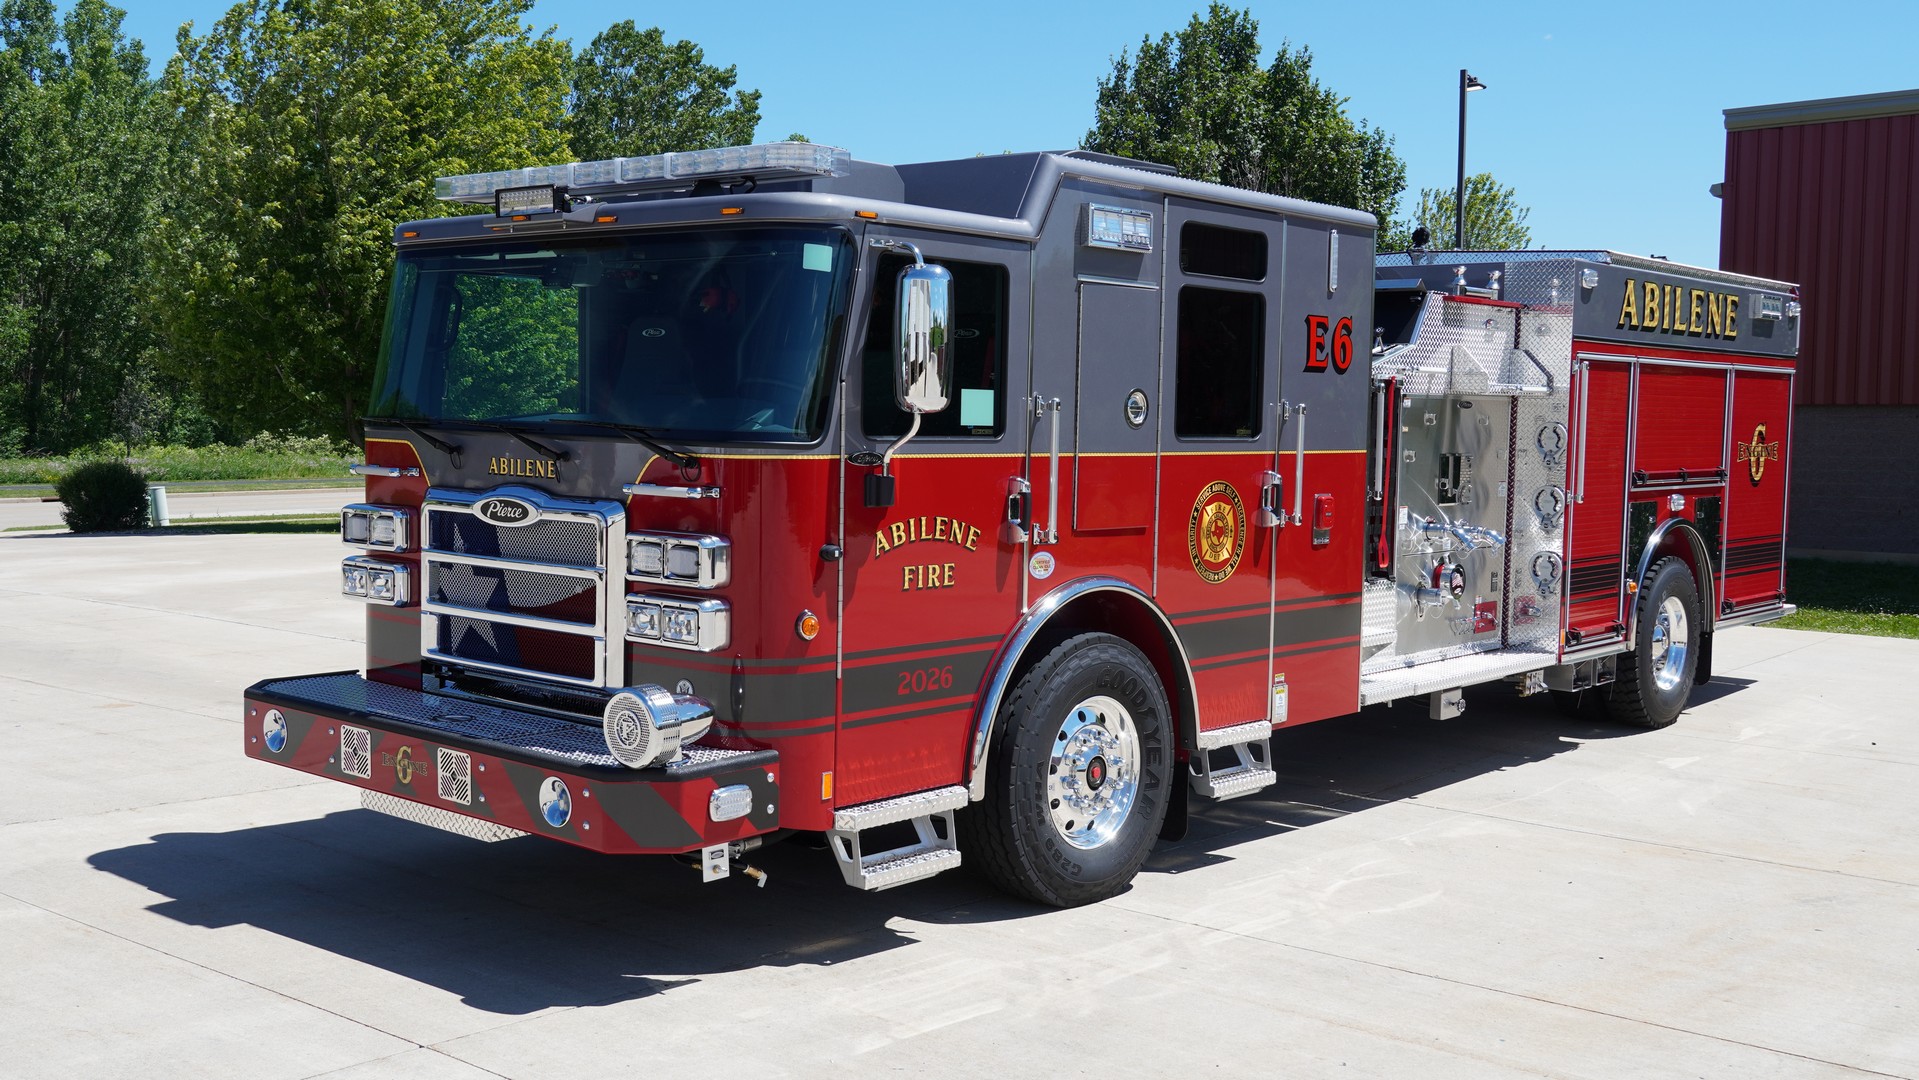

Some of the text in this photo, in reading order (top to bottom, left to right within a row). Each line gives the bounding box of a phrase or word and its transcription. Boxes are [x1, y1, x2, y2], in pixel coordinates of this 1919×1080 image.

[1617, 278, 1739, 339] ABILENE
[1304, 315, 1353, 374] E6
[488, 456, 556, 478] ABILENE
[1737, 423, 1778, 482] ENGINE 6
[1212, 484, 1226, 492] ABOVE
[486, 500, 523, 518] Pierce
[1210, 504, 1226, 514] FIRE
[875, 516, 981, 558] ABILENE
[903, 563, 955, 590] FIRE
[897, 665, 953, 695] 2026
[1097, 666, 1162, 821] GOODYEAR
[381, 745, 428, 784] ENGINE 6
[1045, 837, 1082, 877] G289
